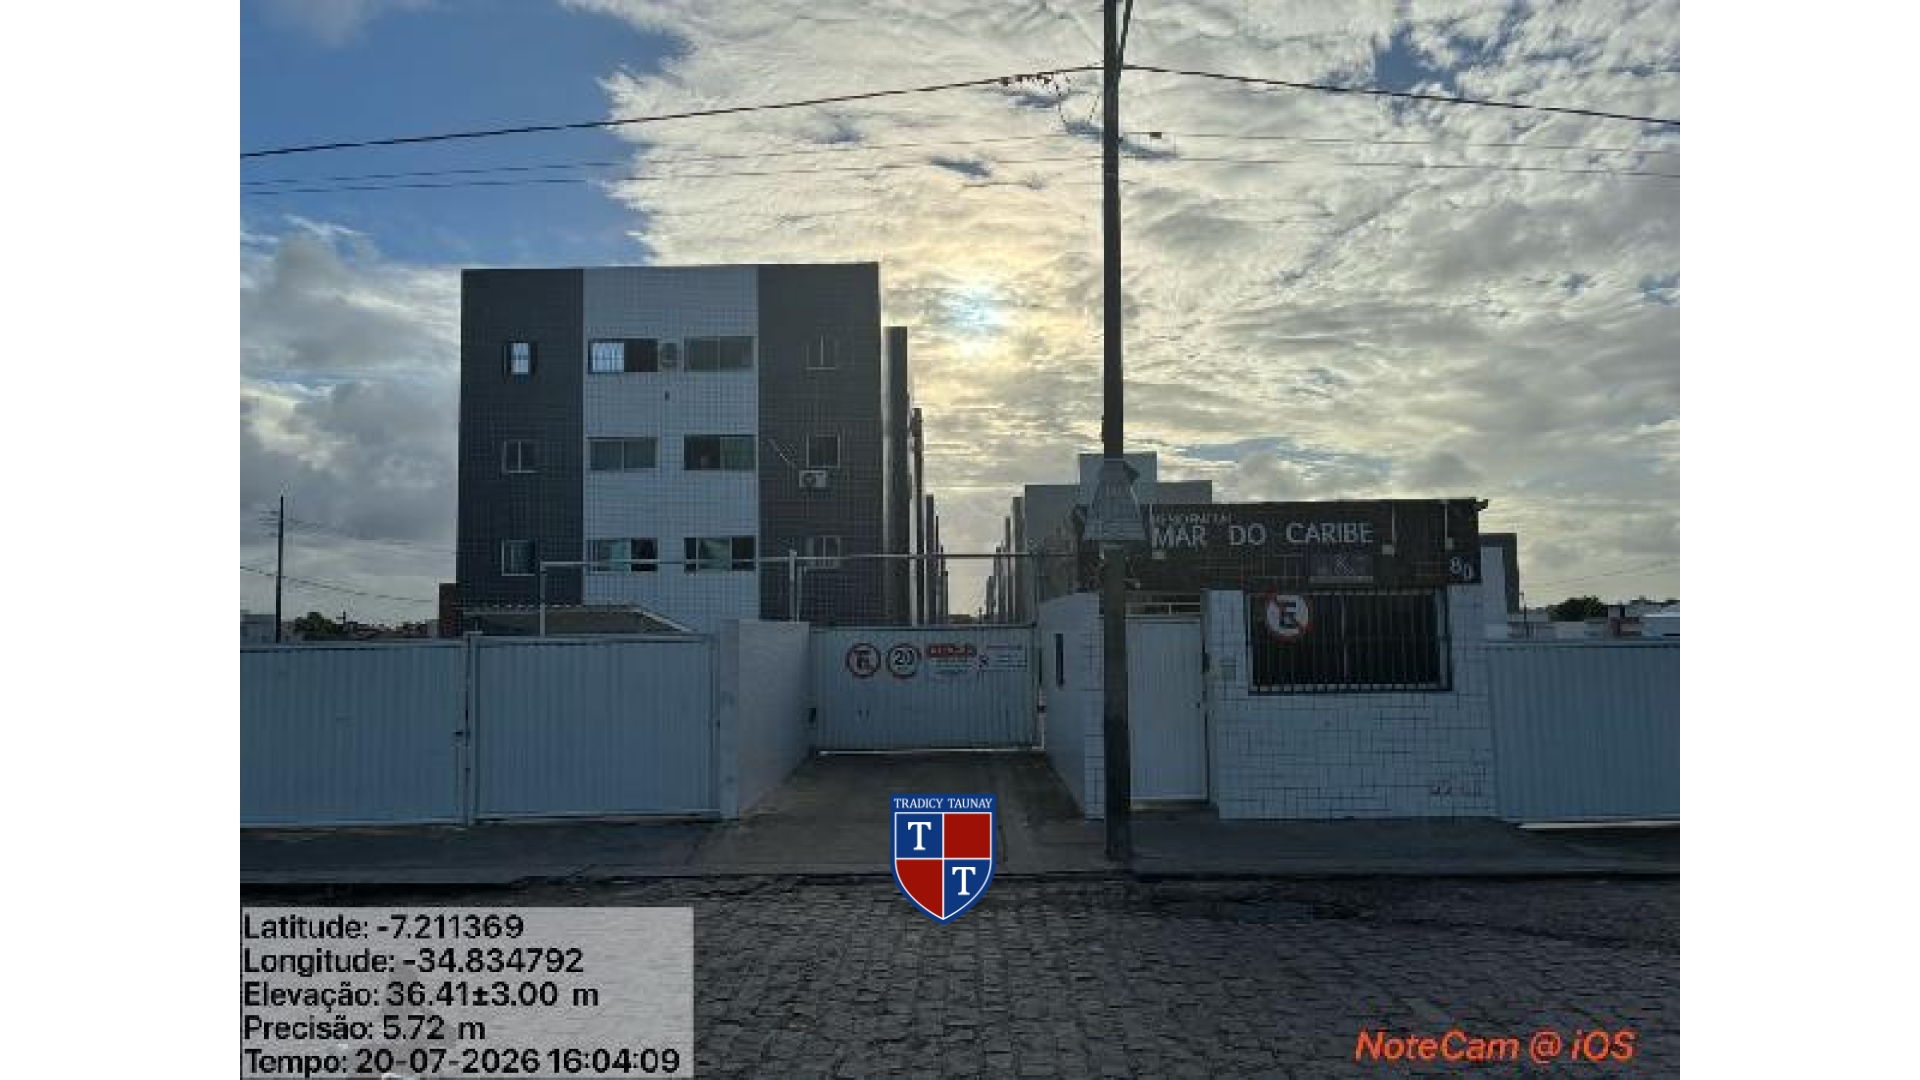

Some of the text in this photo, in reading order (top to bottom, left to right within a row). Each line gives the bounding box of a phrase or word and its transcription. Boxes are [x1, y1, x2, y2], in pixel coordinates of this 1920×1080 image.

[1152, 521, 1374, 549] MAR DO CARIBE
[1450, 556, 1475, 582] 80
[894, 649, 914, 666] 20
